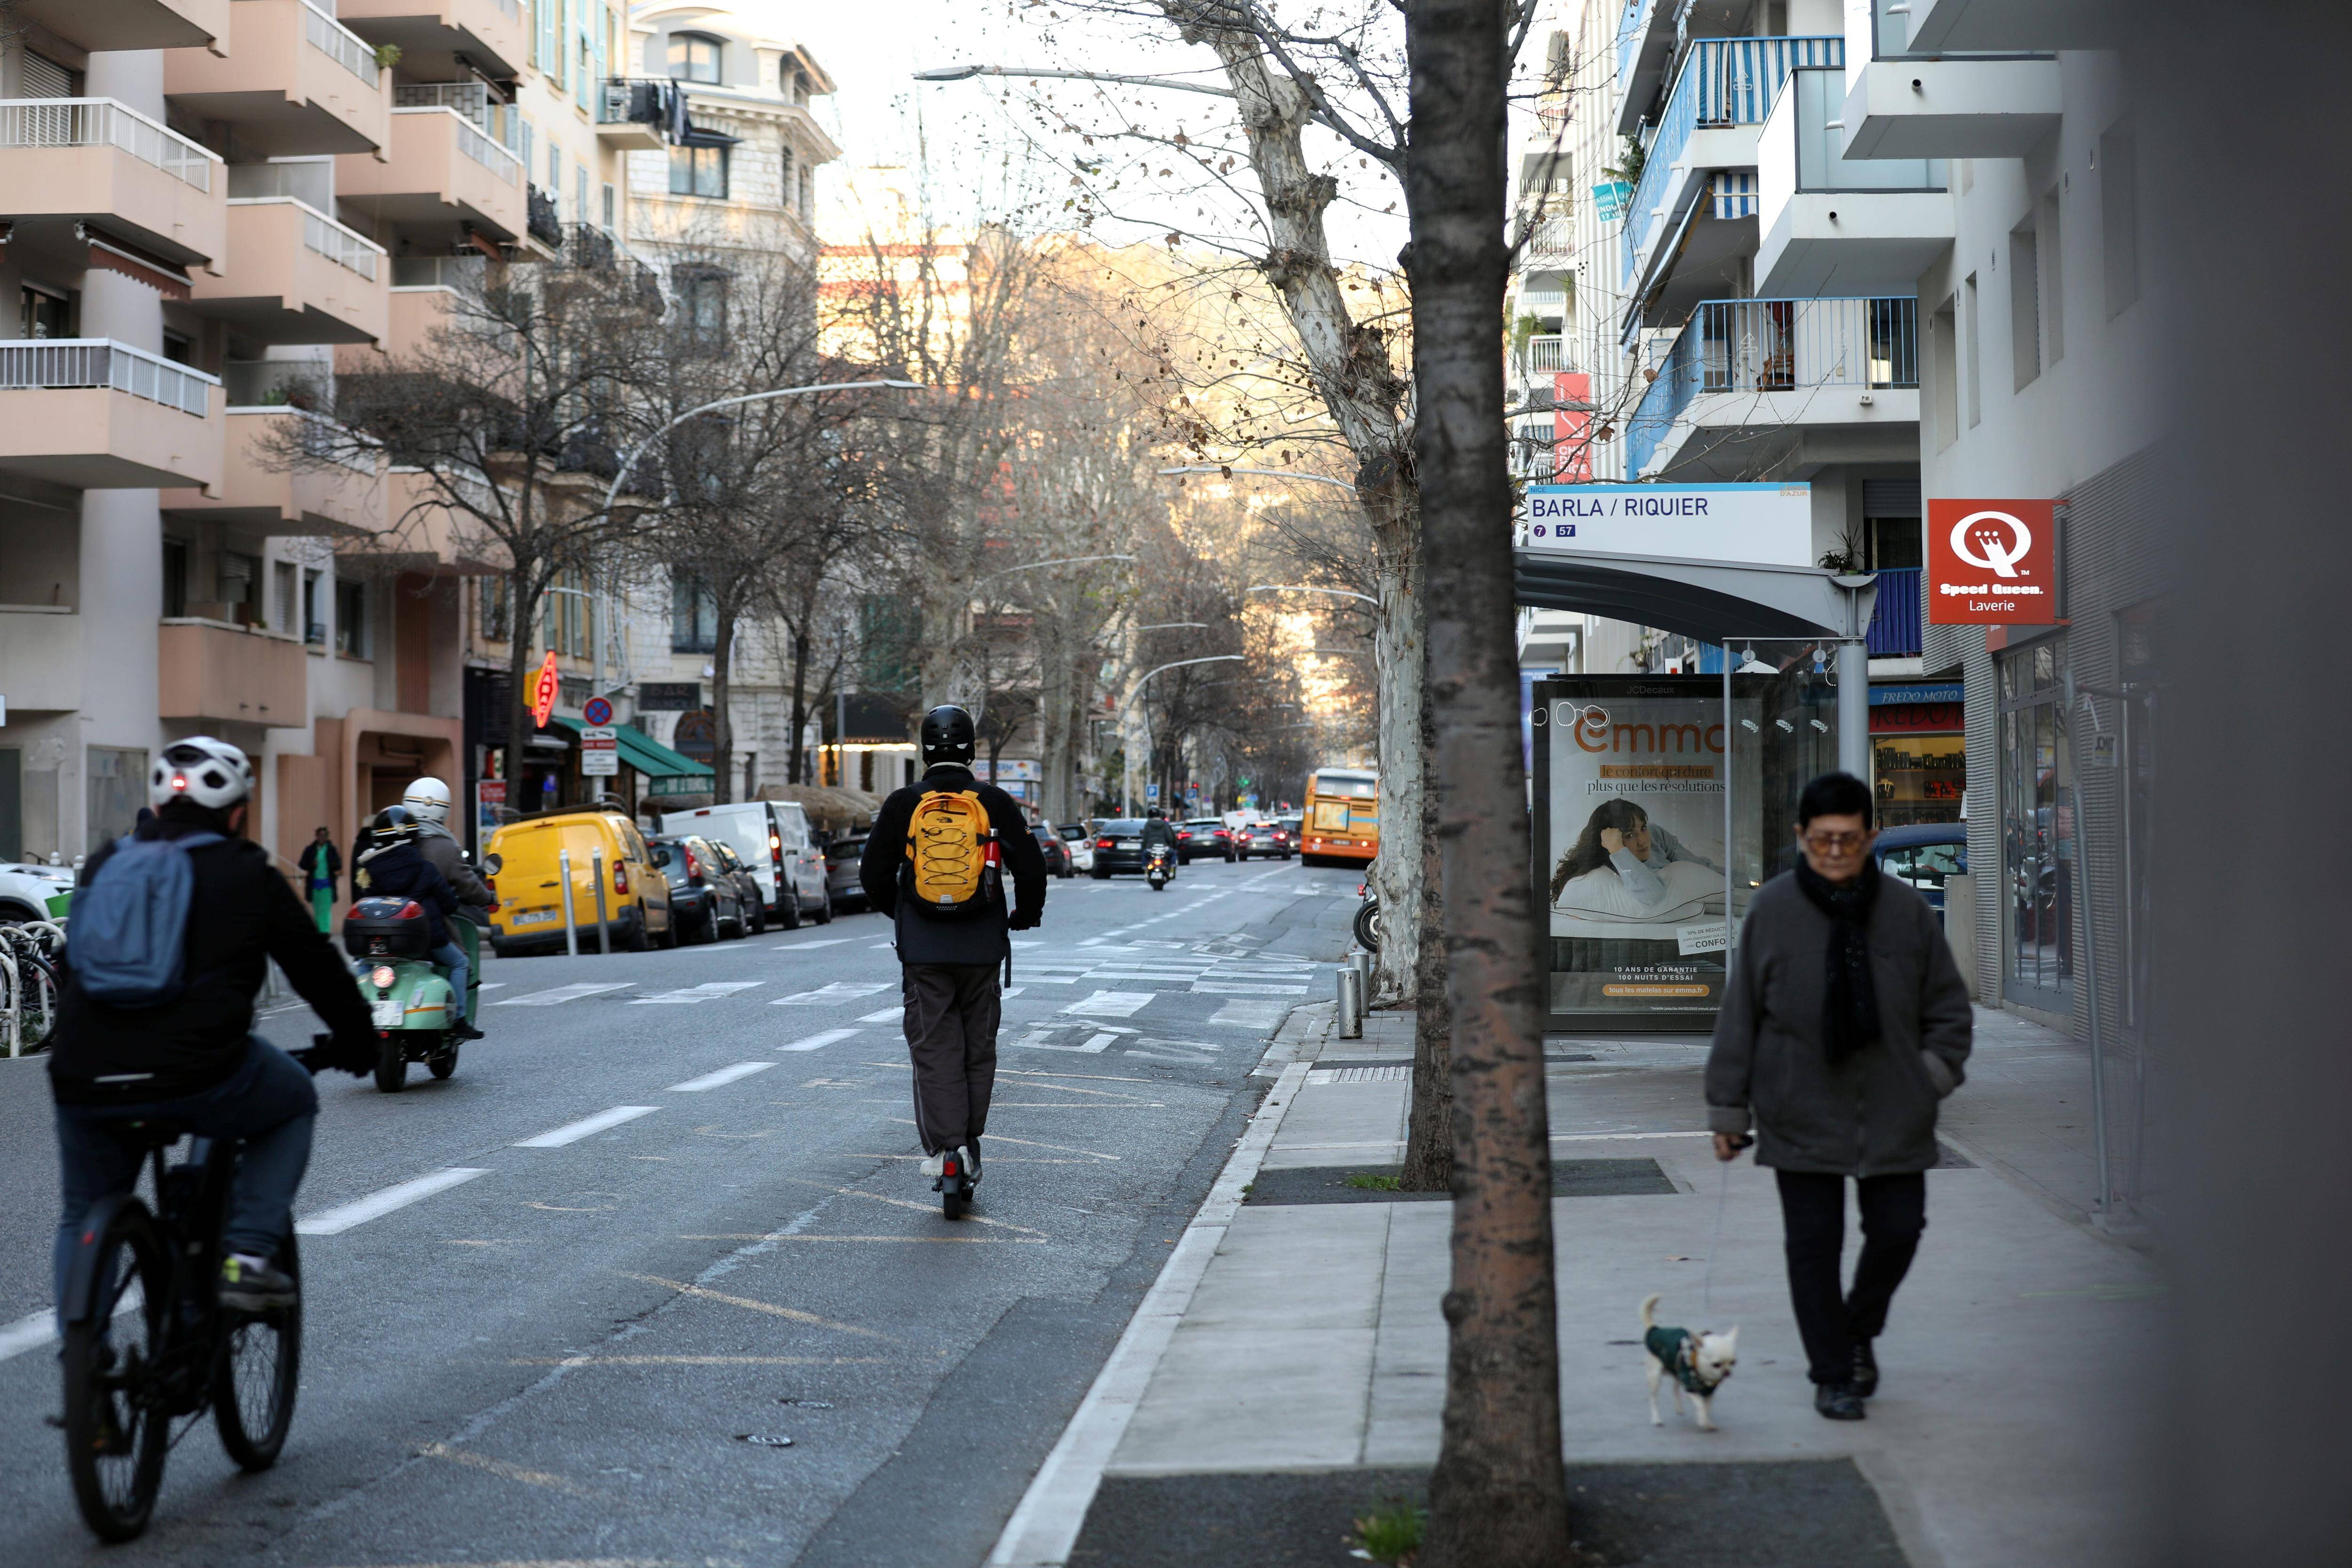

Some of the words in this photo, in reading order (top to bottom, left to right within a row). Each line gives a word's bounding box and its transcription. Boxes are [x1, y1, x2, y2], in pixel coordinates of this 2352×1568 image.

[1533, 499, 1604, 517] BARLA
[1610, 498, 1618, 517] /
[1625, 498, 1708, 516] RIQUIER
[1536, 527, 1544, 536] 7
[1558, 526, 1573, 536] 57
[1939, 583, 1988, 597] Speed
[1969, 600, 2015, 612] Laverie
[1627, 685, 1675, 694] JCDecaux
[1882, 692, 1921, 704] FREDO
[1923, 690, 1958, 701] MOTO
[1870, 704, 1949, 728] REDO
[1603, 765, 1613, 777] le
[1615, 764, 1659, 777] confort
[1661, 766, 1681, 780] qui
[1683, 765, 1711, 777] dure
[1588, 780, 1613, 795] plus
[1615, 782, 1639, 795] que
[1641, 780, 1657, 792] les
[1660, 780, 1725, 792] résolutions
